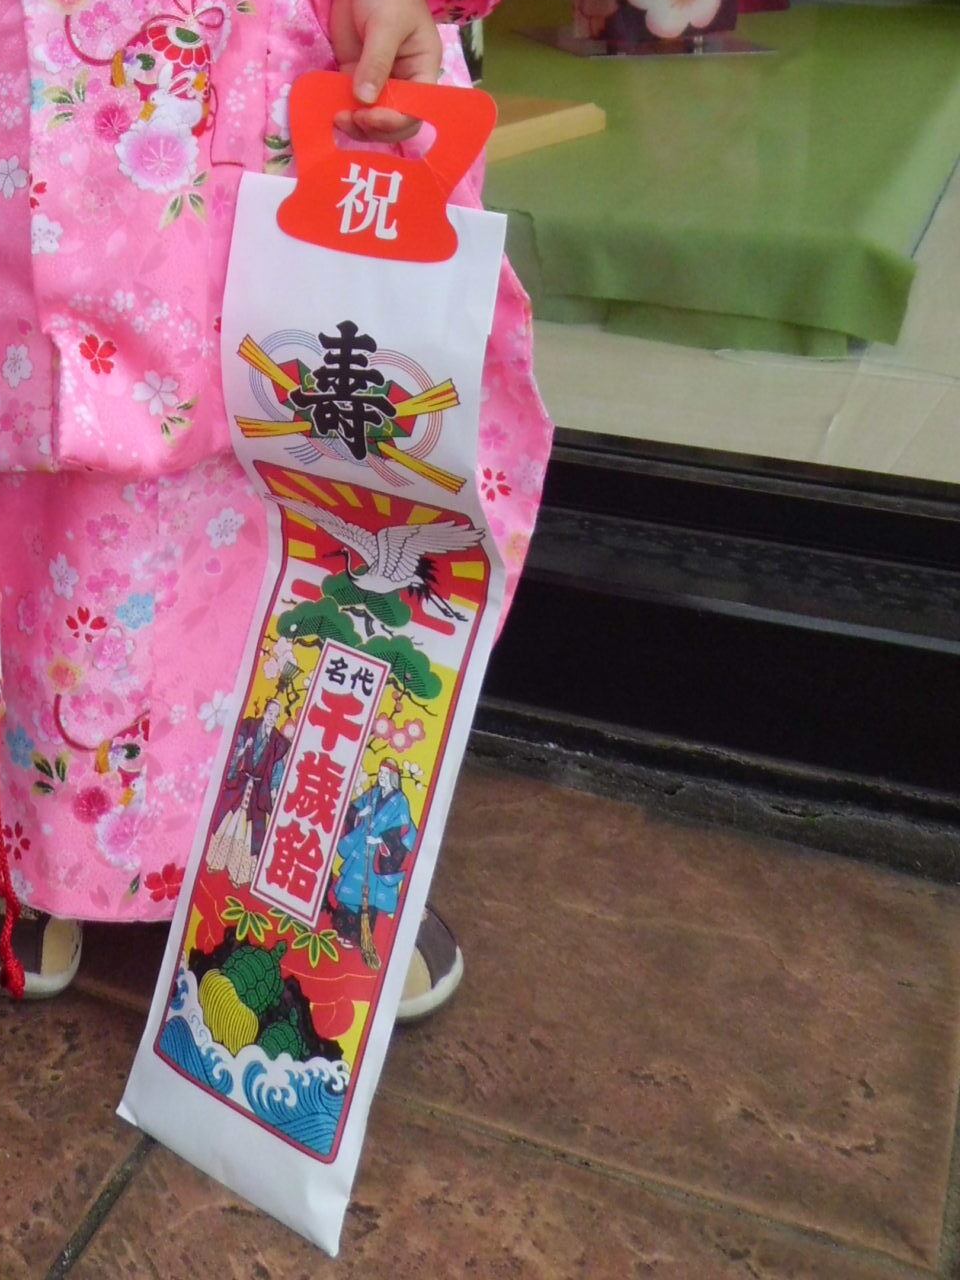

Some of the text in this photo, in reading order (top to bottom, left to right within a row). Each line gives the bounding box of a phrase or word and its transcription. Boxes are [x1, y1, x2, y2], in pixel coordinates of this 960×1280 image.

[336, 162, 403, 240] 祝
[325, 657, 374, 696] 名代
[265, 687, 364, 903] 千歳飴
